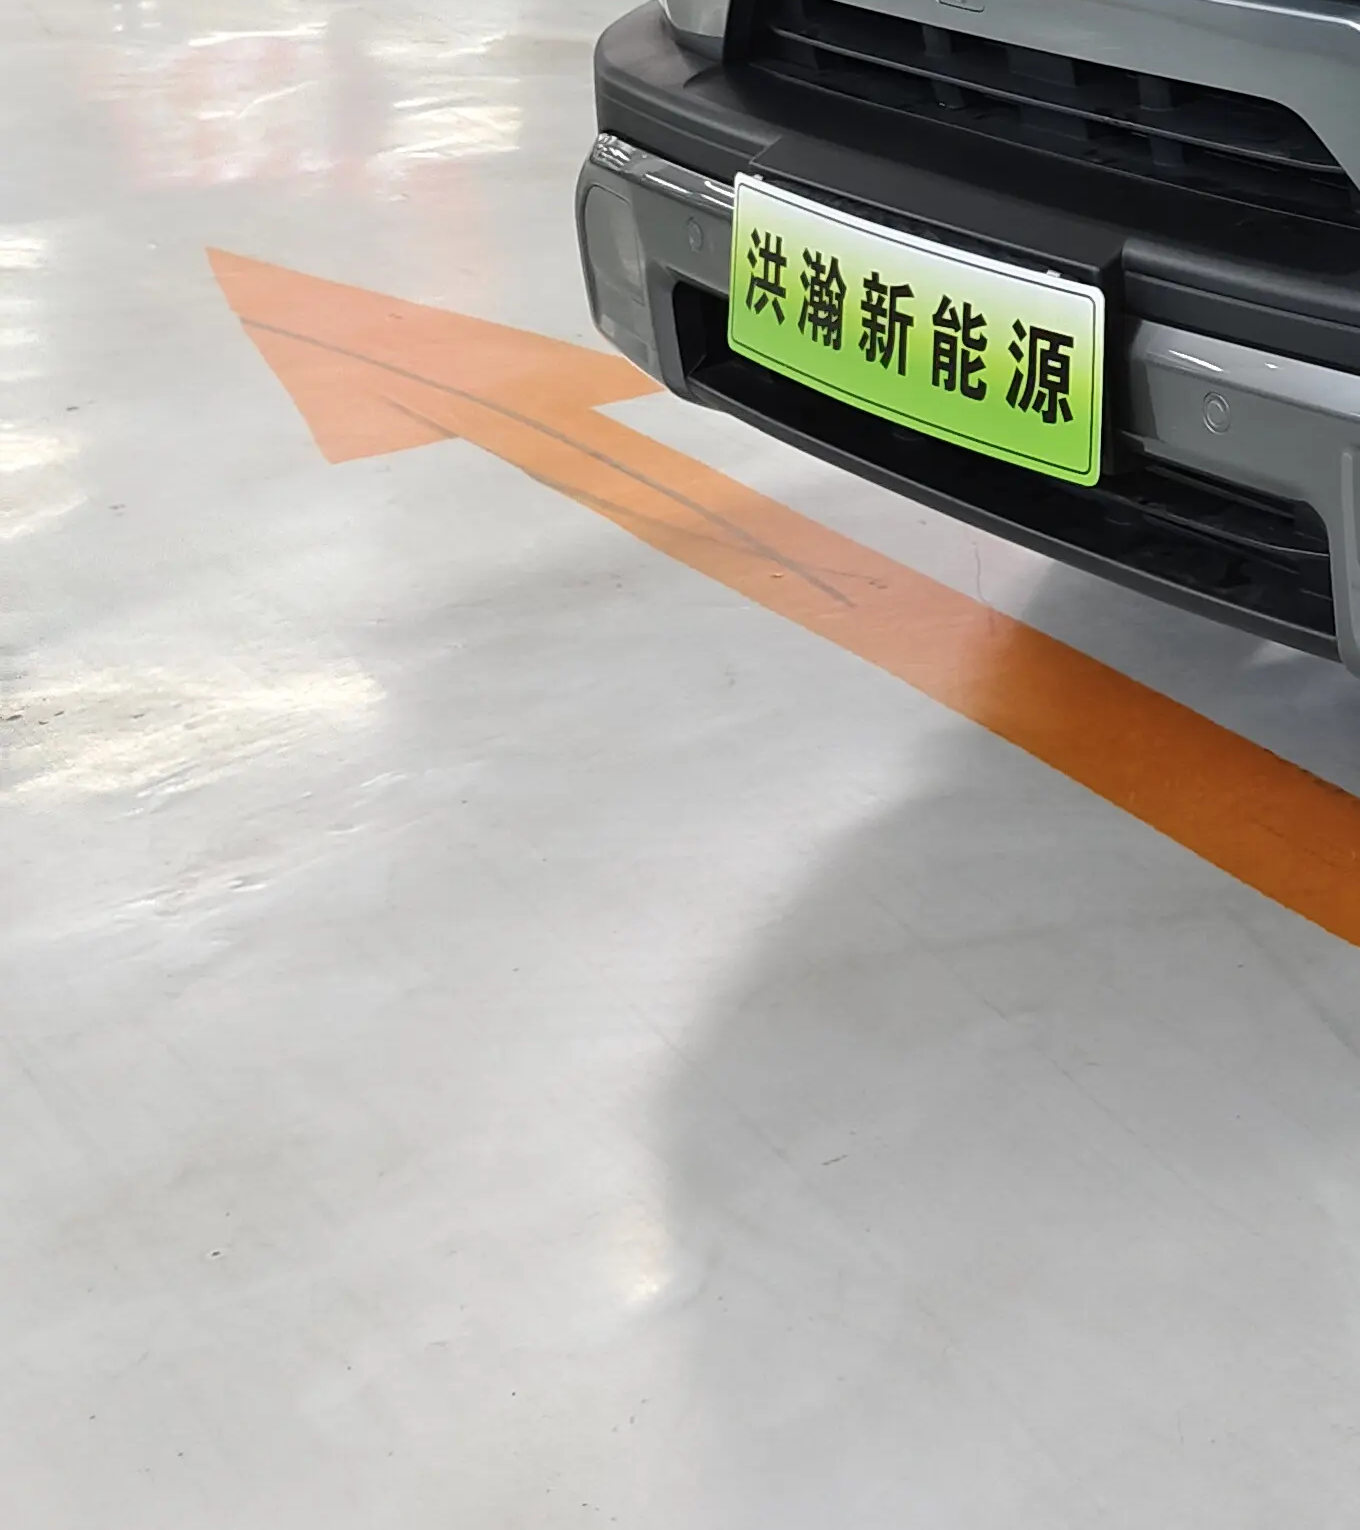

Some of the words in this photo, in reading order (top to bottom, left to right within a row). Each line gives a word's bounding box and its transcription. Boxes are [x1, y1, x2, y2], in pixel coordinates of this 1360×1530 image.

[745, 227, 1074, 425] 洪瀚新能源
